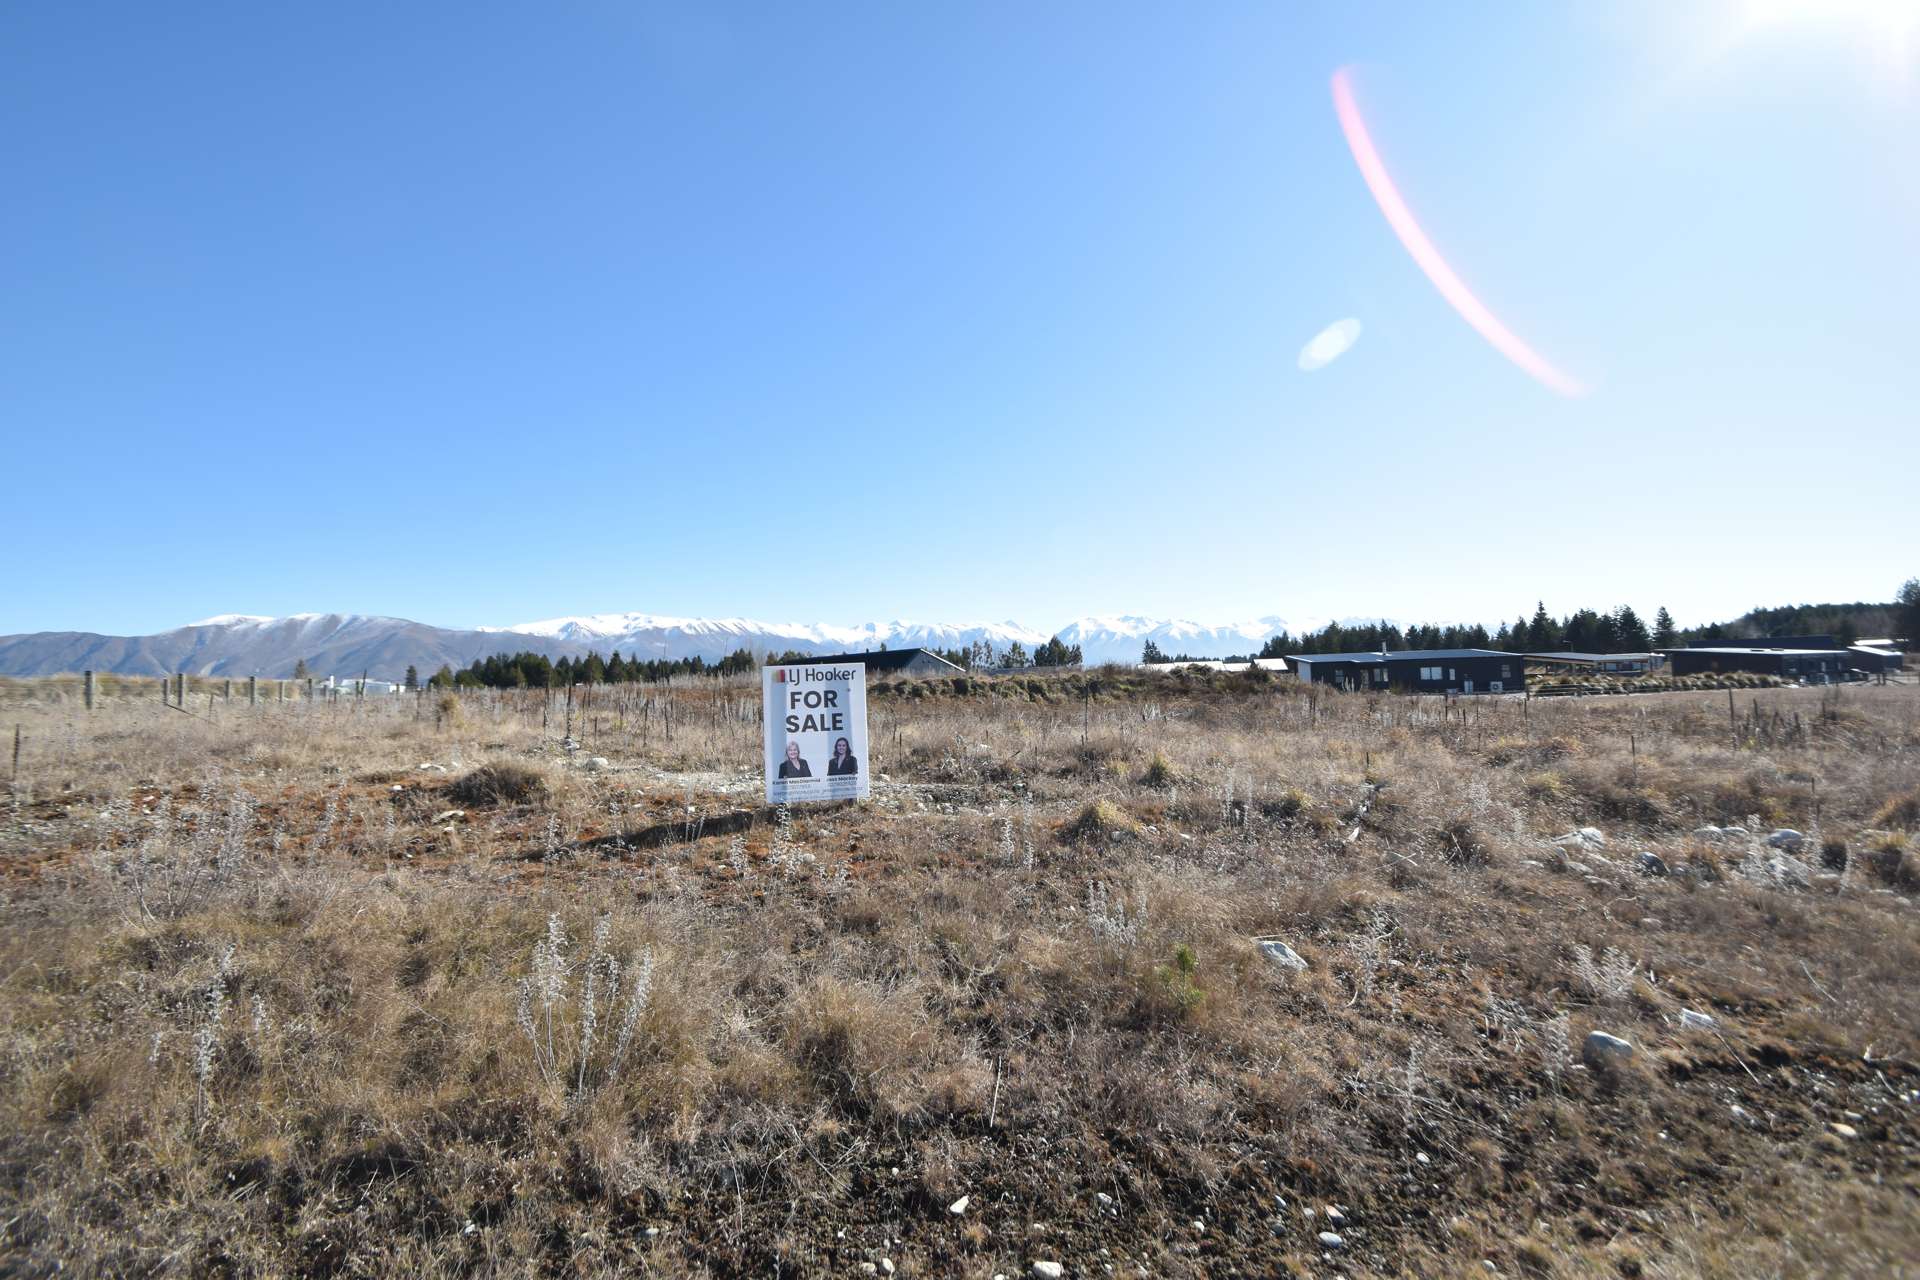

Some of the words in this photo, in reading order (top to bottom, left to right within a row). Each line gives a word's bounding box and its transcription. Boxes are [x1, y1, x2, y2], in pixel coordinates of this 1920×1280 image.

[789, 669, 800, 686] LJ
[805, 667, 856, 682] Hooker
[790, 690, 838, 709] FOR
[785, 713, 844, 733] SALE
